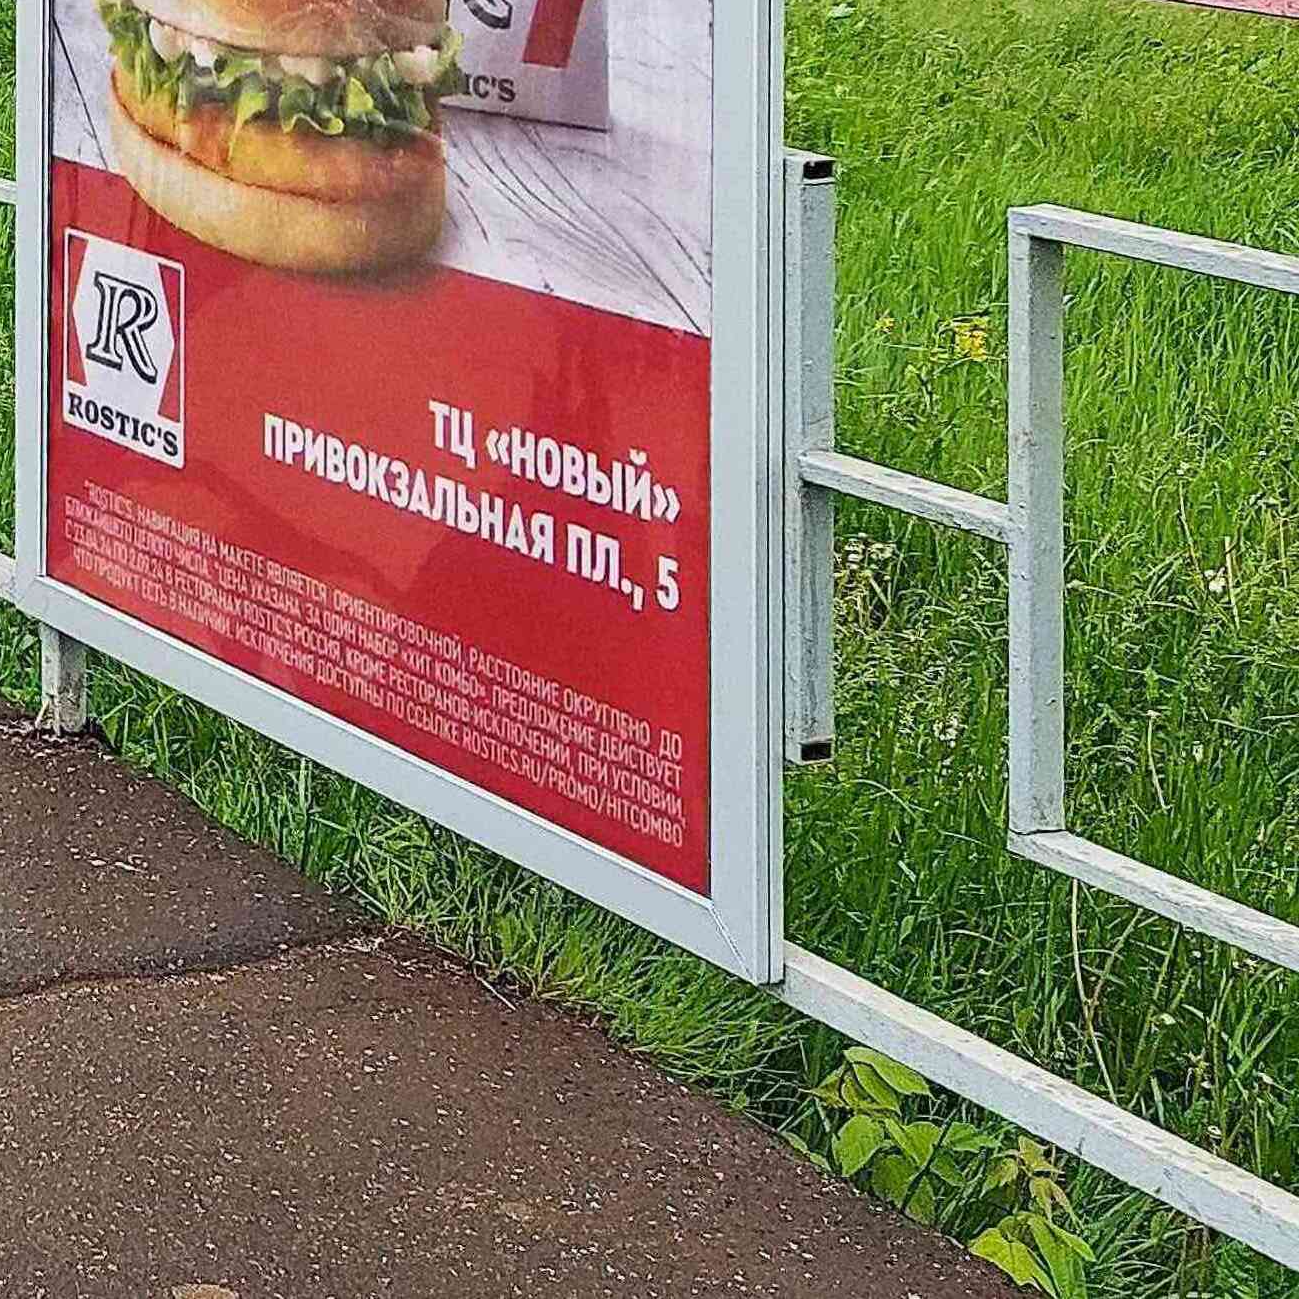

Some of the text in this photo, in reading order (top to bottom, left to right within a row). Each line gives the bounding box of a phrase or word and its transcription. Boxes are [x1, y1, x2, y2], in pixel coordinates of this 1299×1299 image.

[68, 392, 179, 457] ROSTIC'S
[86, 271, 158, 385] R
[264, 412, 681, 612] ПРИВОКЗАЛЬНАЯ ПЛ., 5
[429, 401, 682, 524] ТЦ «НОВЫЙ»
[137, 503, 200, 551] НАВИГАЦИЯ
[202, 531, 217, 558] НА
[220, 539, 263, 577] МАКЕТЕ
[267, 559, 326, 605] ЯВЛЯЕТСЯ
[334, 588, 465, 665] ОРИЕНТИРОВОЧНОЙ,
[469, 645, 559, 706] РАССТОЯНИЕ
[563, 686, 649, 745] ОКРУГЛЕНО
[659, 726, 682, 759] ДО
[141, 576, 167, 608] ЕСТЬ
[235, 619, 314, 676] ИСКЛЮЧЕНИЯ
[316, 656, 382, 709] ДОСТУПНЫ
[386, 688, 403, 718] ПО
[407, 698, 458, 744] ССЫЛКЕ
[462, 723, 682, 849] ROSTICS.RU/PROMO/HITCOMBO
[175, 567, 241, 617] РЕСТОРАНАХ
[294, 620, 344, 664] РОССИЯ,
[346, 644, 385, 683] КРОМЕ
[579, 748, 607, 784] ПРИ
[612, 763, 685, 820] УСЛОВИИ,
[250, 576, 300, 619] УКАЗАНА
[305, 601, 320, 628] ЗА
[323, 609, 355, 644] ОДИН
[358, 624, 398, 663] НАБОР
[492, 683, 594, 751] ПРЕДЛОЖЕНИЕ
[600, 730, 682, 789] ДЕЙСТВУЕТ
